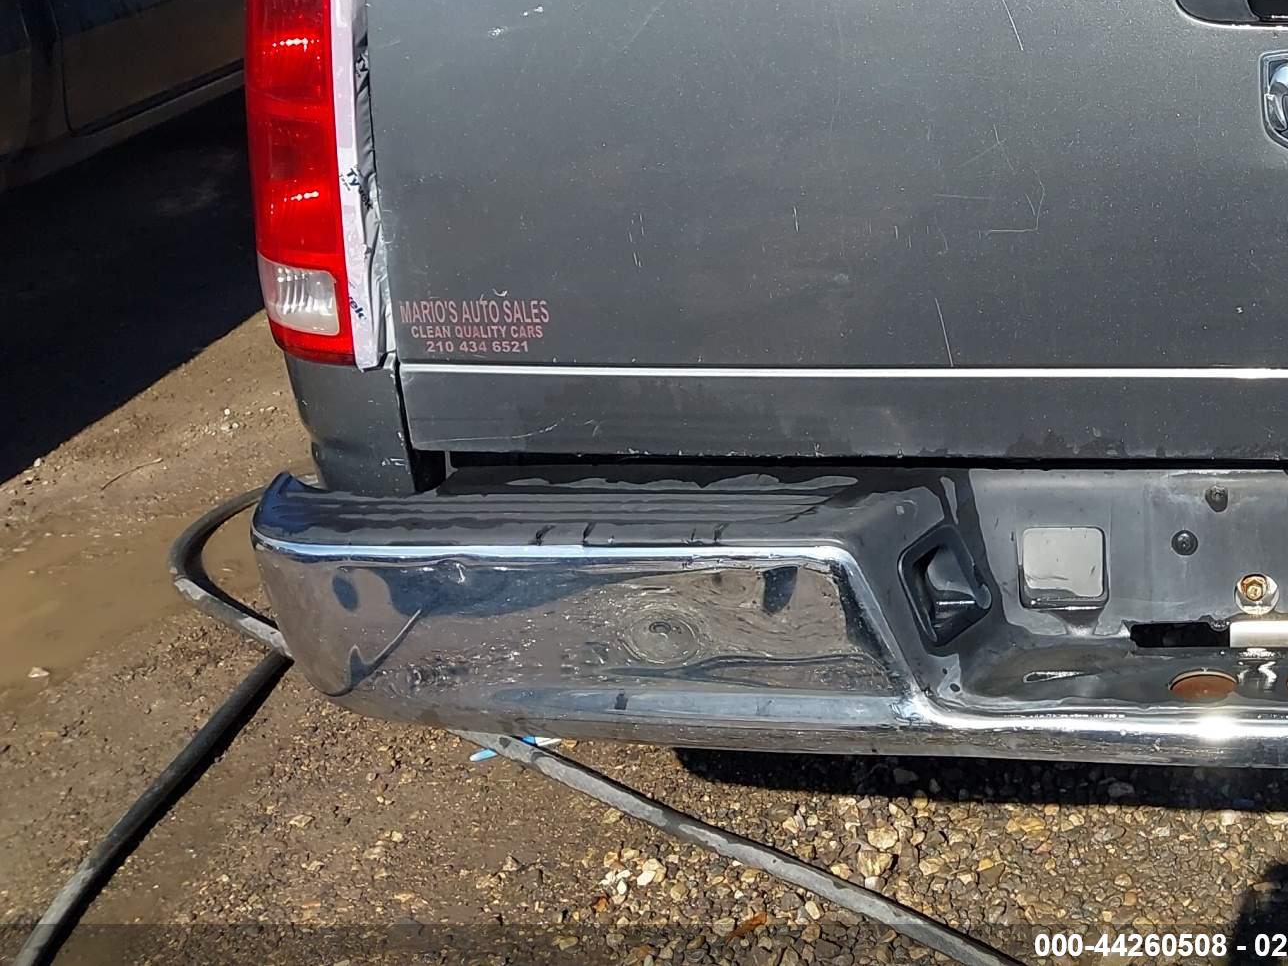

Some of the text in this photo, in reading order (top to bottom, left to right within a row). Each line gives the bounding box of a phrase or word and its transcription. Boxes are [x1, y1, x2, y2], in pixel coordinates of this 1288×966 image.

[399, 300, 550, 323] MARIO'S AUTO SALES
[410, 325, 545, 339] CLEAN QUALITY CARS
[425, 340, 530, 353] 210 434 6521
